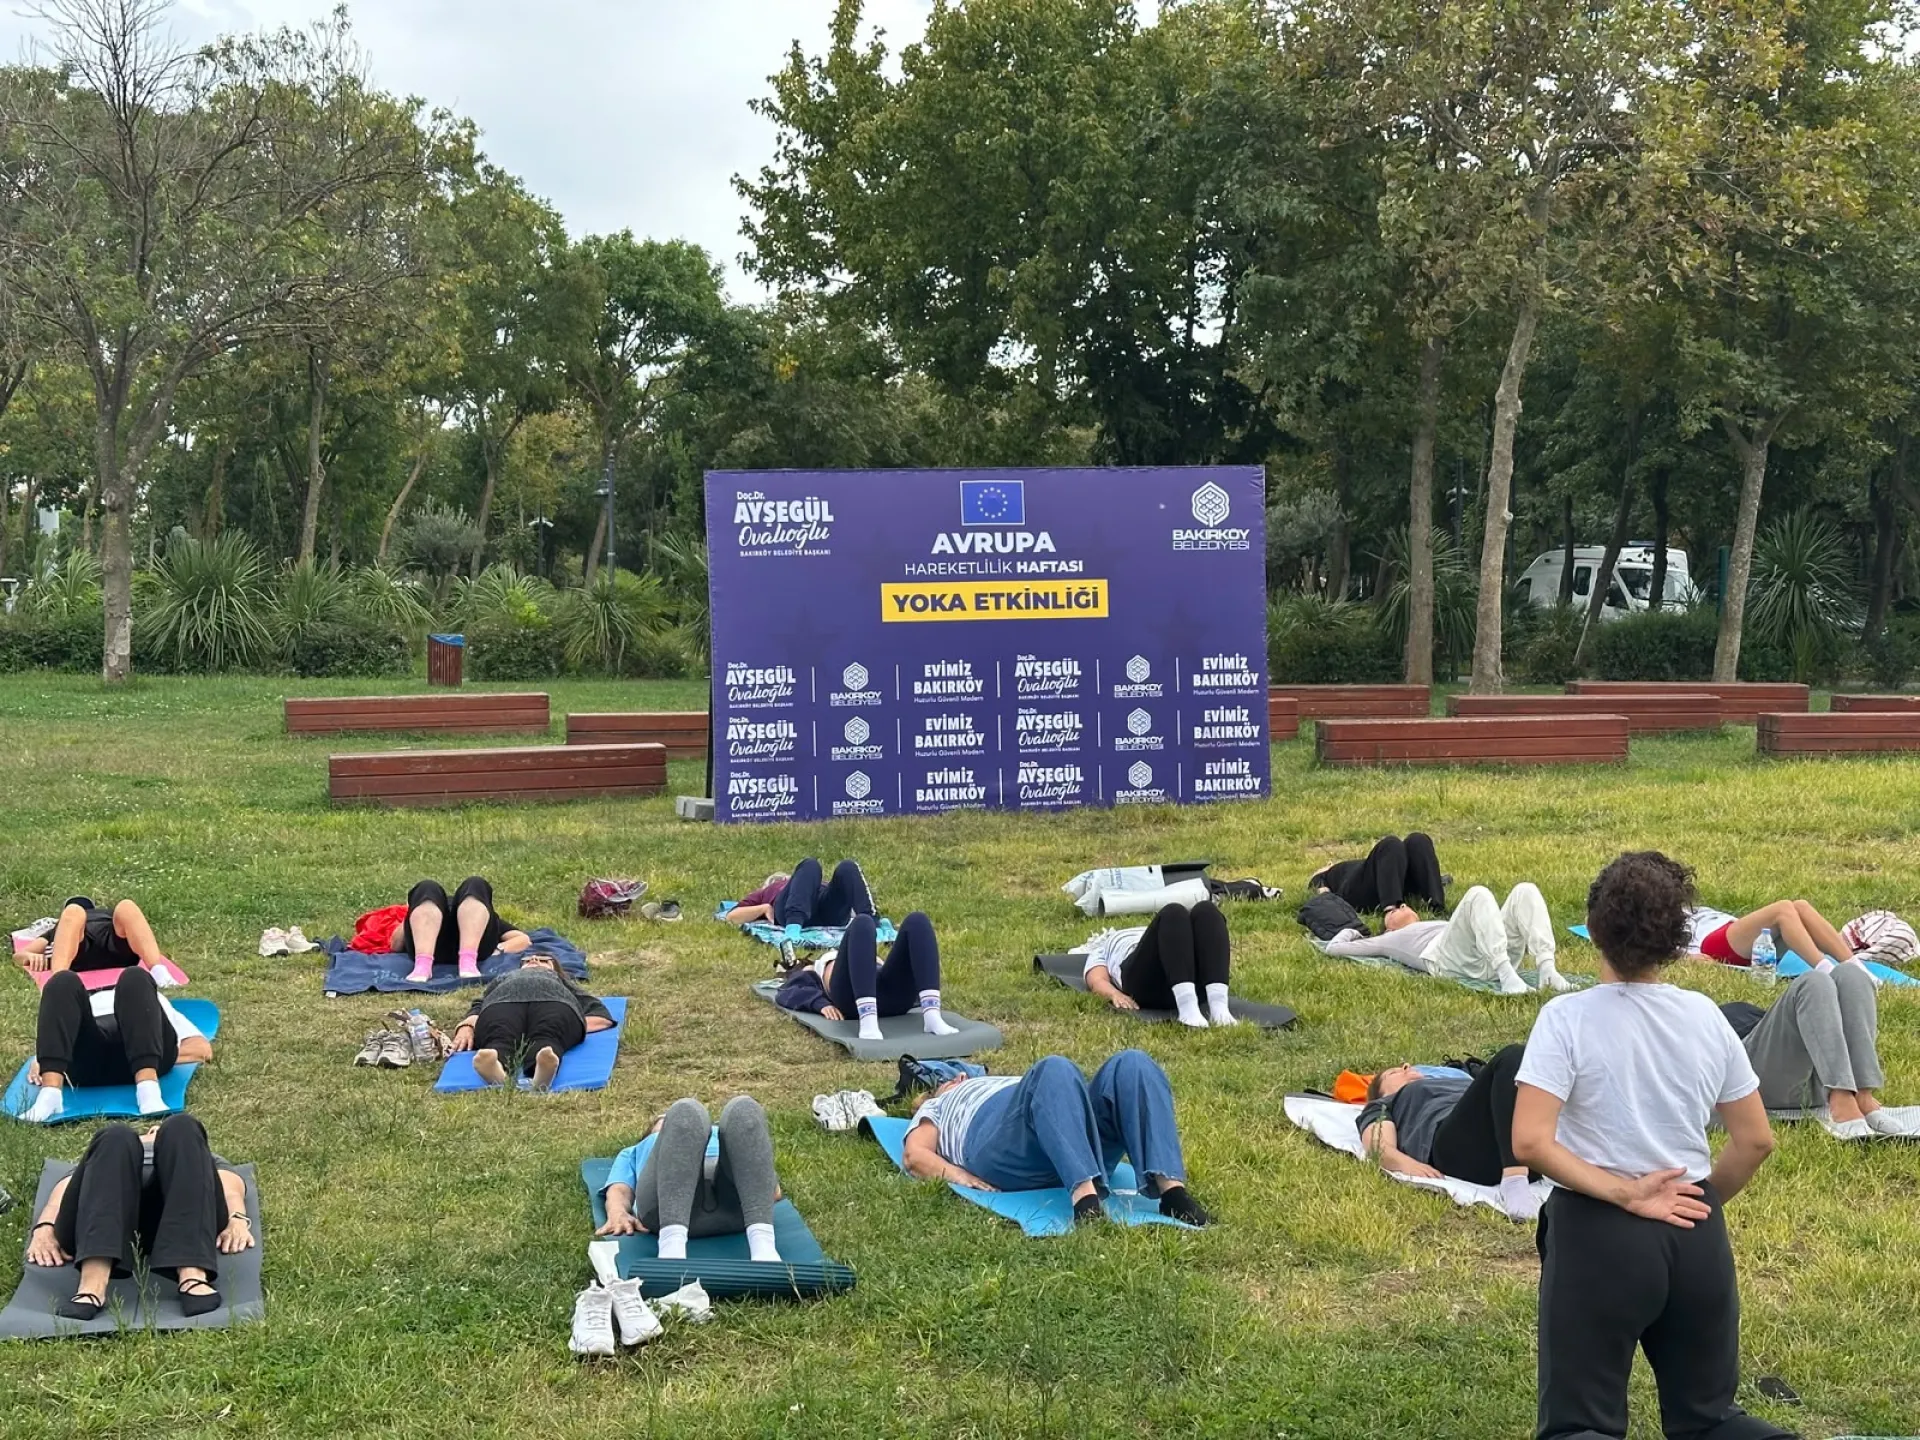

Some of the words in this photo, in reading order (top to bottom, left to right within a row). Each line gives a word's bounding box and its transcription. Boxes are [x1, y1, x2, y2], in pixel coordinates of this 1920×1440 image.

[734, 497, 834, 527] AYŞEGÜL
[739, 521, 829, 549] Ovalıoğlu
[931, 532, 1056, 554] AVRUPA
[905, 558, 1012, 575] HAREKETLİLİK
[1016, 560, 1083, 573] HAFTASI
[893, 593, 967, 613] YOKA
[974, 586, 1099, 611] ETKİNLİĞİ
[924, 659, 972, 677] EVİMİZ
[1015, 658, 1081, 679] AYŞEGÜL
[1203, 653, 1248, 670] EVİMİZ
[726, 666, 796, 687] AYŞEGÜL
[914, 677, 984, 694] BAKIRKÖY
[1193, 671, 1259, 687] BAKIRKÖY
[925, 713, 973, 731] EVİMİZ
[1016, 711, 1082, 732] AYŞEGÜL
[1204, 705, 1249, 723] EVİMİZ
[727, 720, 797, 742] AYŞEGÜL
[915, 730, 985, 748] BAKIRKÖY
[1194, 722, 1260, 739] BAKIRKÖY
[927, 767, 974, 784] EVİMİZ
[1017, 764, 1084, 786] AYŞEGÜL
[1205, 758, 1250, 775] EVİMİZ
[728, 774, 798, 797] AYŞEGÜL
[1195, 774, 1261, 792] BAKIRKÖY
[916, 784, 986, 802] BAKIRKÖY
